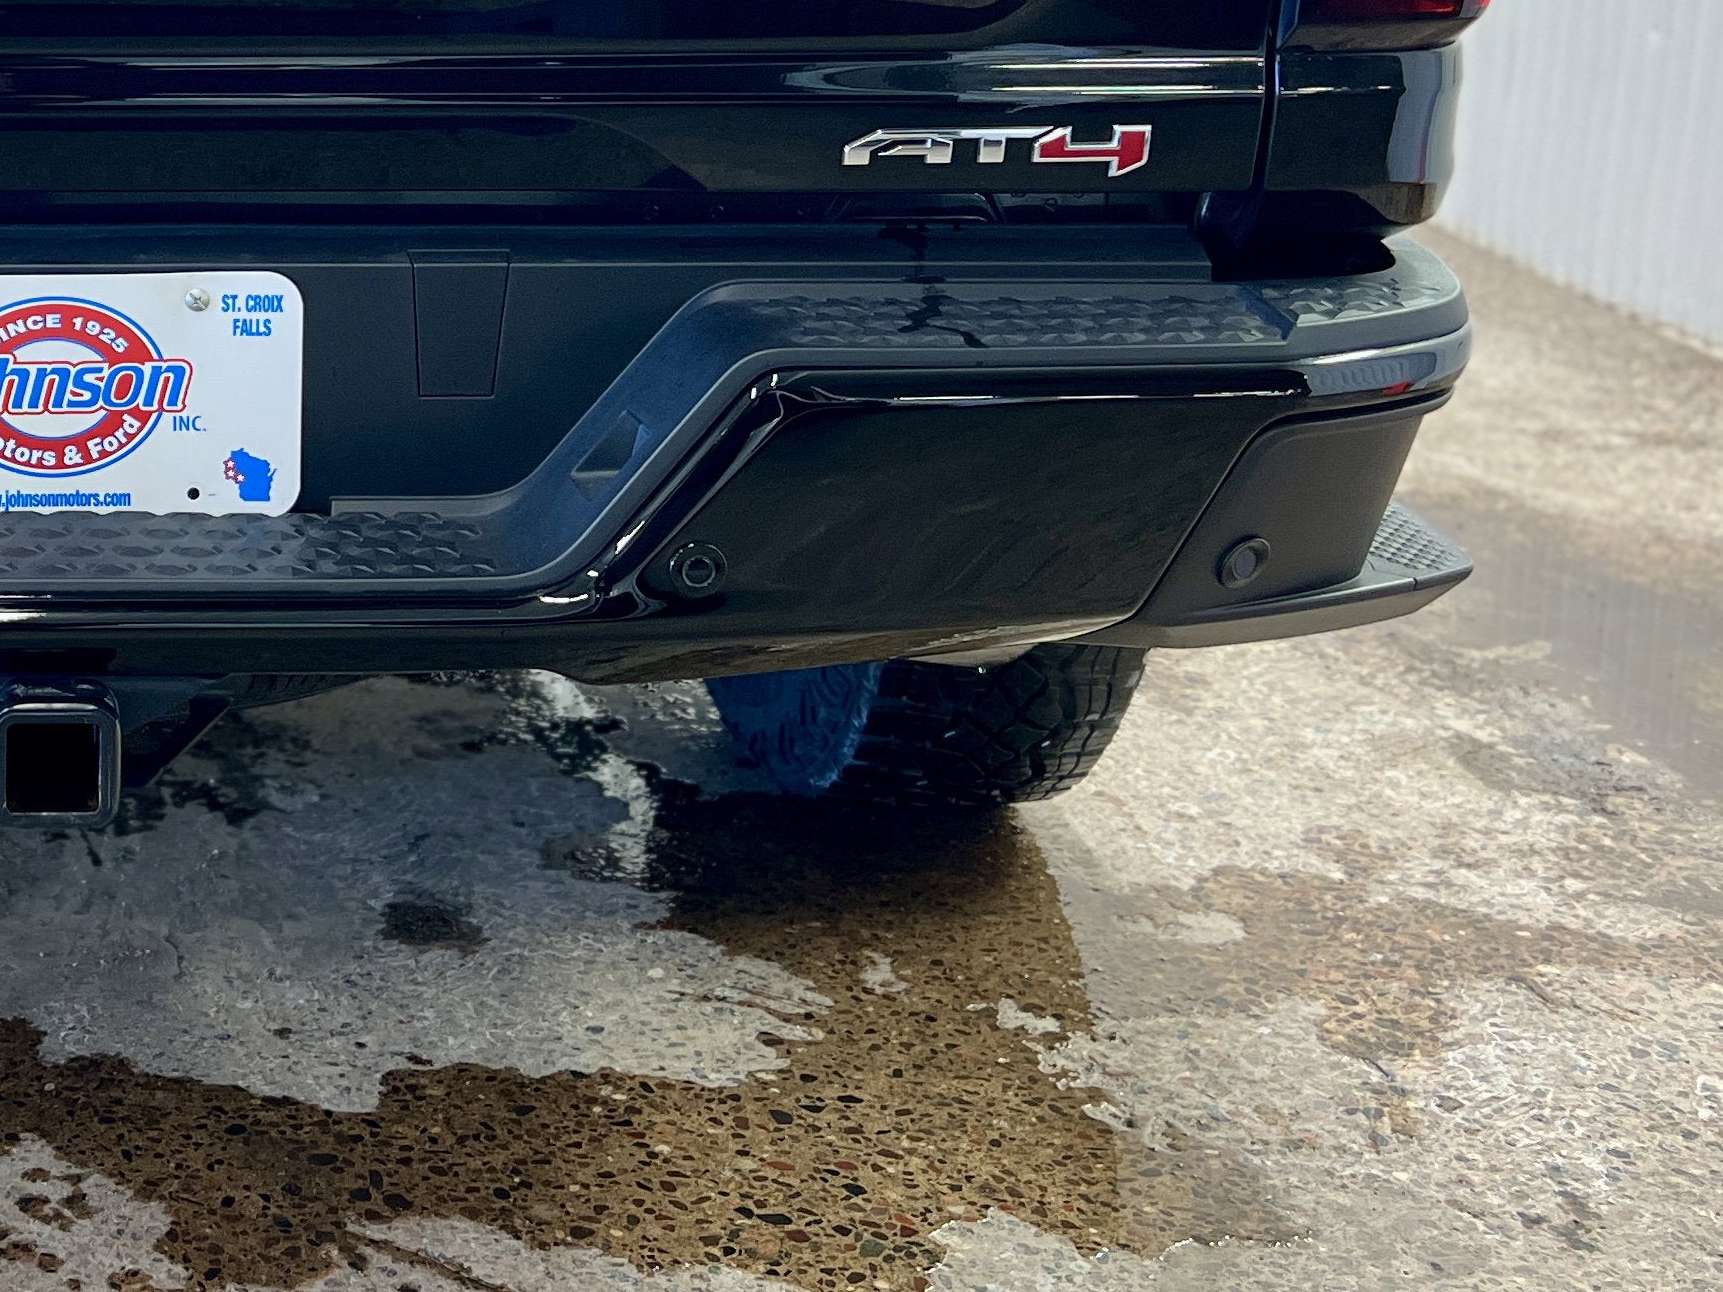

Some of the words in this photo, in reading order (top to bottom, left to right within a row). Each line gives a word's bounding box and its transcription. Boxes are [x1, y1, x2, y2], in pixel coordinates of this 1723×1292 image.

[841, 124, 1152, 178] AT4
[221, 294, 241, 313] ST.
[245, 294, 284, 313] CROIX
[72, 316, 129, 354] 1925
[232, 318, 272, 337] FALLS
[172, 415, 207, 432] INC.
[63, 445, 84, 466] &
[86, 414, 142, 461] Ford
